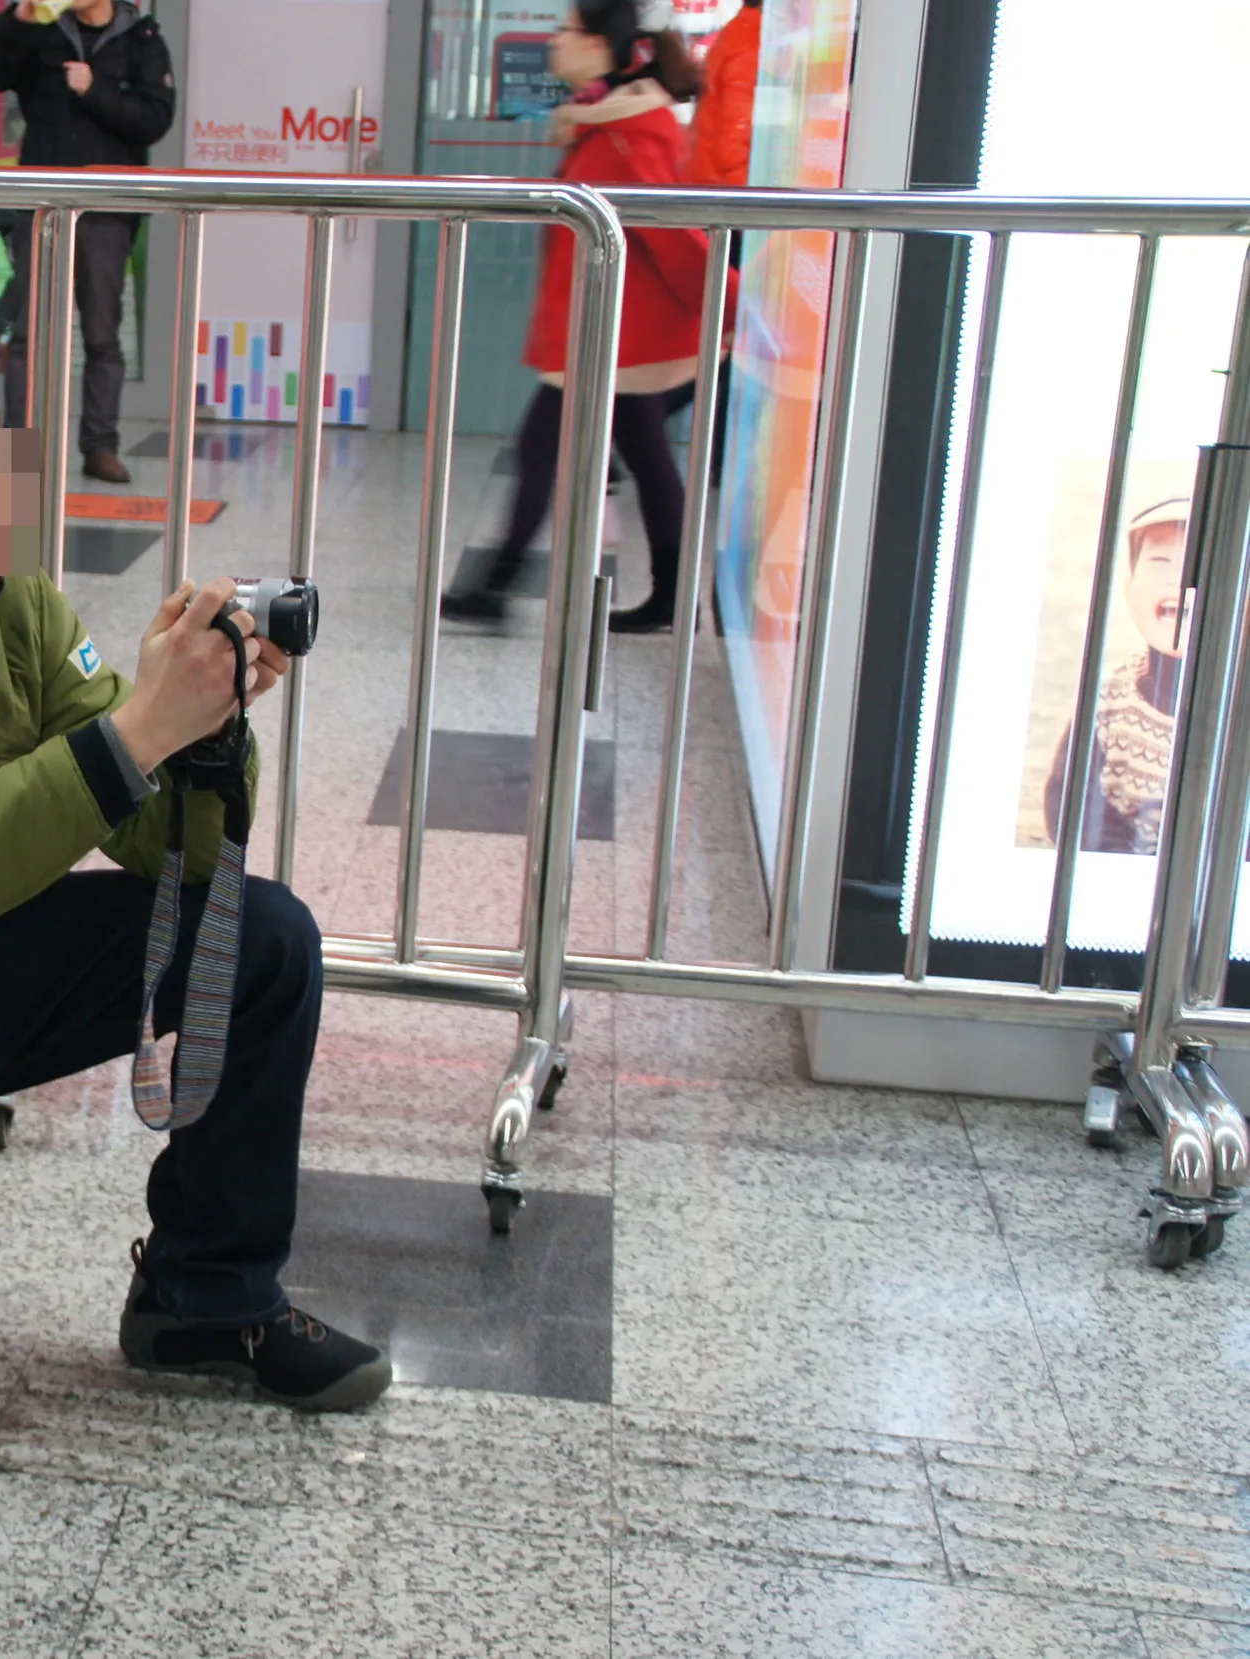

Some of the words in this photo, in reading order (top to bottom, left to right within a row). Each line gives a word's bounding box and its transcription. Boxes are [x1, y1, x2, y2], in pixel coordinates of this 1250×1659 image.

[193, 120, 246, 139] Meet
[281, 106, 378, 143] More
[194, 142, 288, 163] 不只是便利
